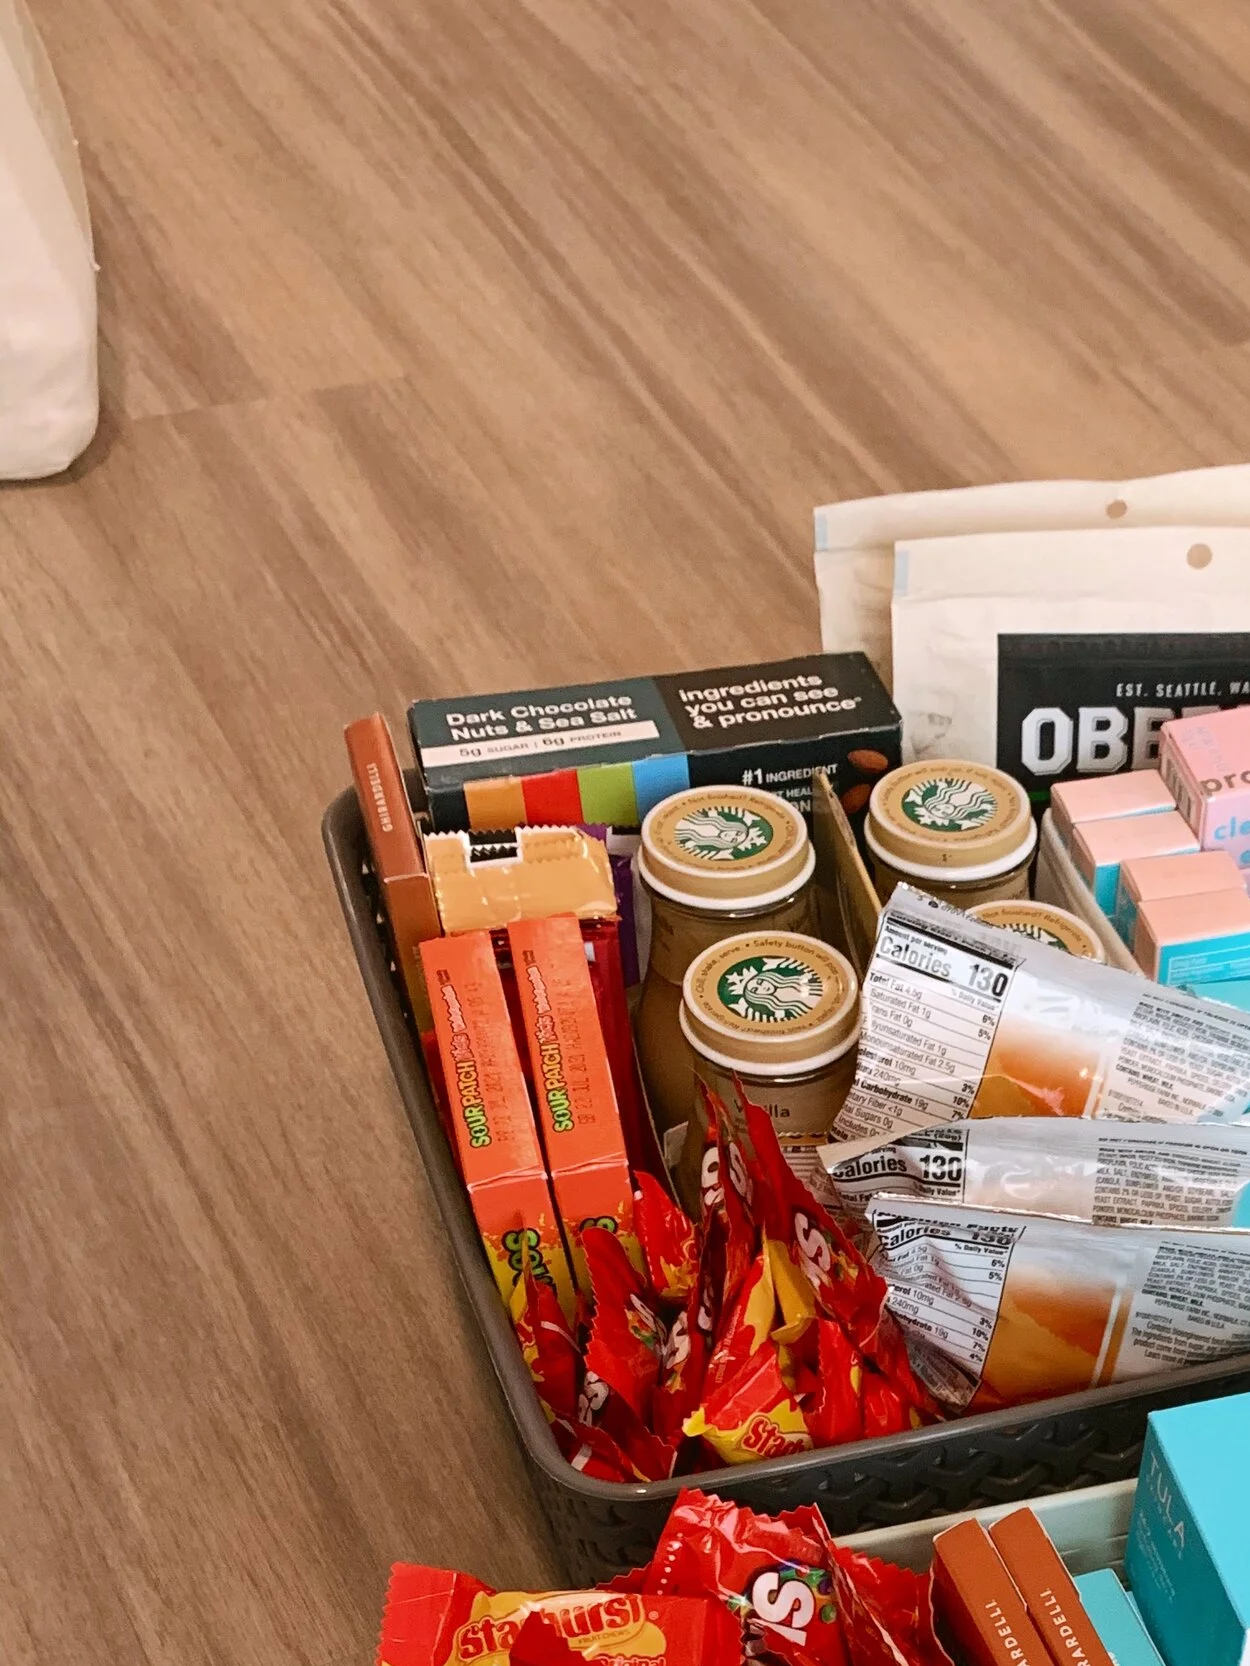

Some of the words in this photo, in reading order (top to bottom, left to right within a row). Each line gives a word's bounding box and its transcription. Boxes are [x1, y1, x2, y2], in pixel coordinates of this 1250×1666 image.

[679, 673, 822, 702] Ingredients
[684, 699, 733, 718] you
[740, 692, 788, 709] can
[793, 685, 839, 702] see
[1116, 683, 1148, 697] EST.
[1156, 682, 1222, 697] SEATTLE,
[1230, 681, 1250, 695] WA
[445, 708, 504, 727] Dark
[511, 694, 633, 719] Chocolate
[451, 721, 509, 741] Nuts
[515, 719, 533, 734] &
[538, 713, 585, 731] Sea
[590, 707, 638, 726] Salt
[693, 714, 713, 730] &
[460, 745, 482, 759] 5g
[486, 741, 529, 755] SUGAR
[542, 734, 565, 748] 6g
[570, 729, 622, 743] PROTEIN
[742, 768, 763, 785] #1
[879, 935, 952, 978] Calories
[969, 963, 1009, 997] 130
[455, 1057, 482, 1107] PATCH
[538, 1041, 567, 1092] PATCH
[547, 1085, 574, 1133] SOUR
[463, 1103, 492, 1149] SOUR
[919, 1154, 962, 1182] 130
